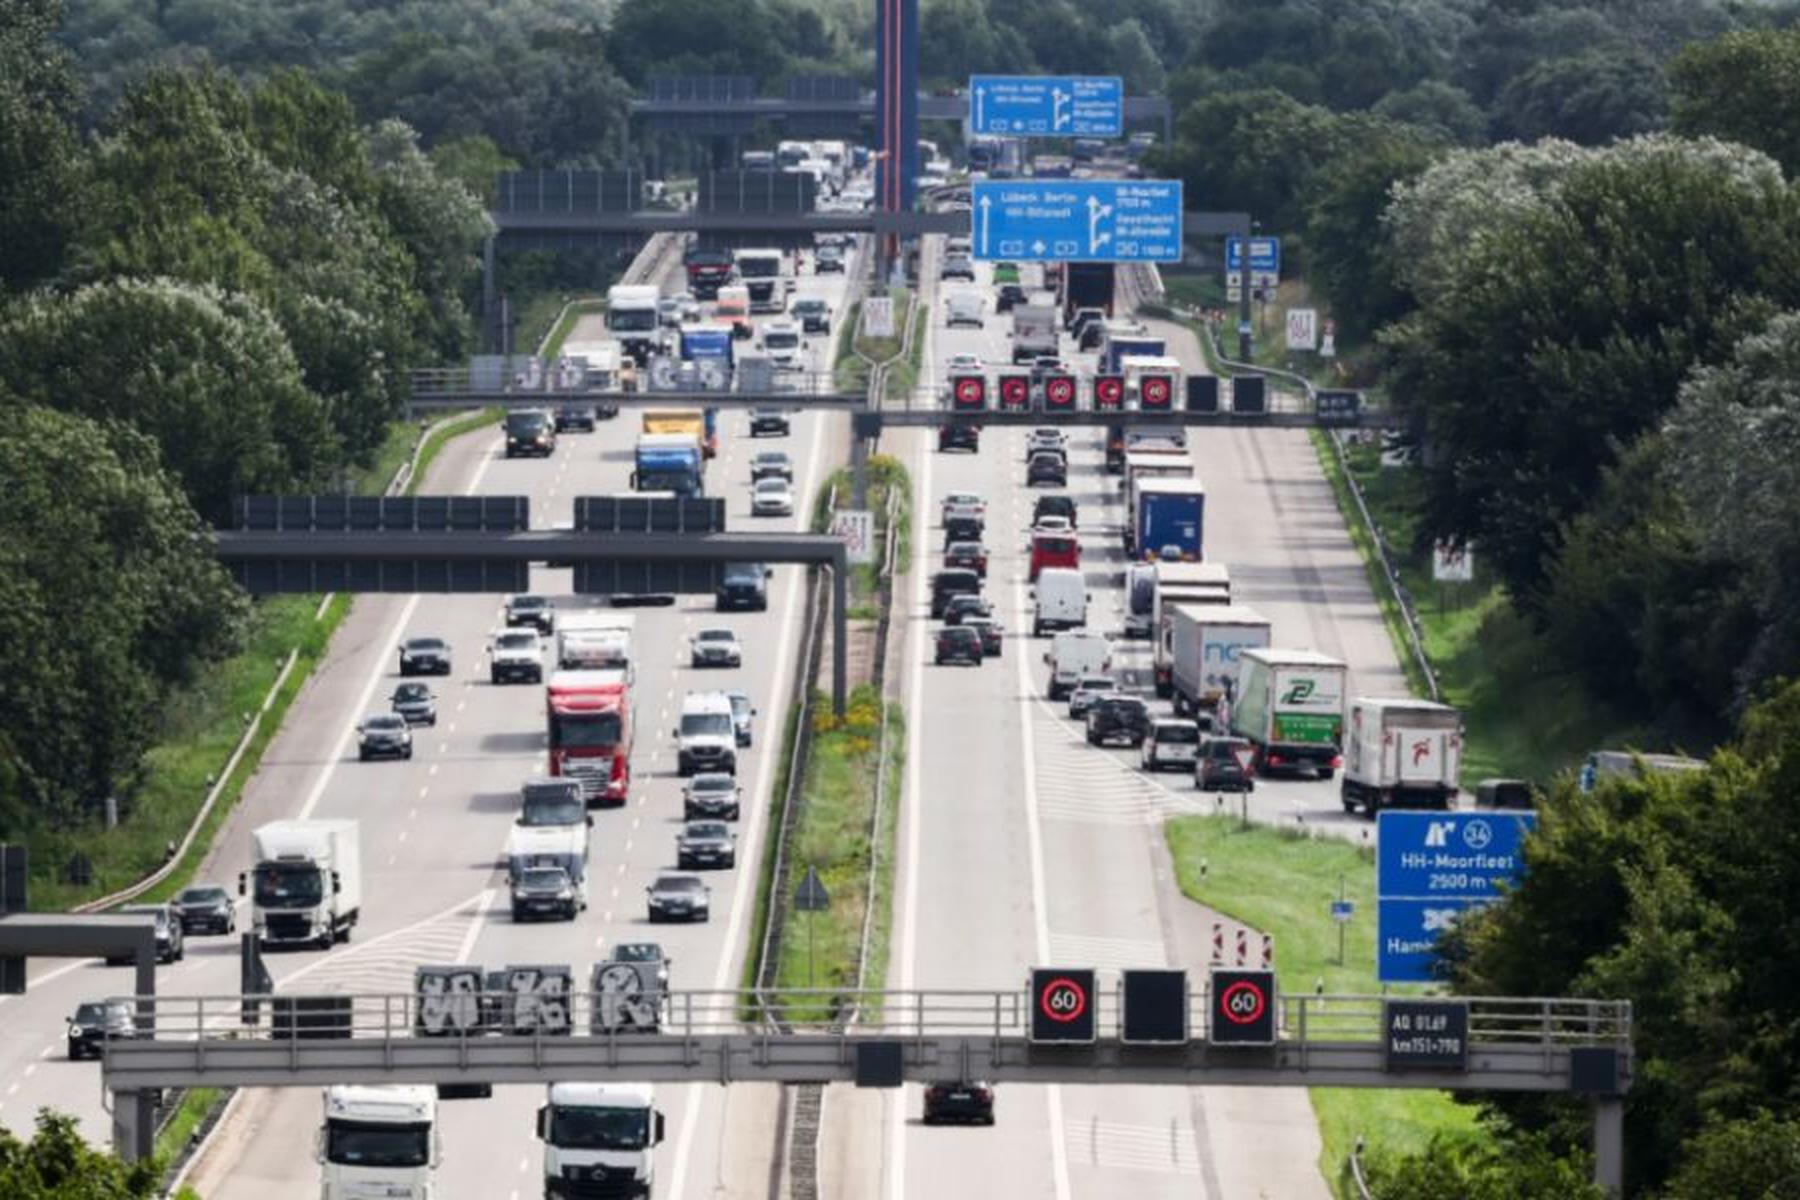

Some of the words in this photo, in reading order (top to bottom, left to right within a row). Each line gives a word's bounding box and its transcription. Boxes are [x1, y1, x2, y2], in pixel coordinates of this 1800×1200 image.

[1401, 853, 1514, 869] HH-Moorfleet
[1428, 874, 1468, 890] 2500
[1470, 877, 1487, 889] m
[1051, 988, 1077, 1010] 60
[1230, 993, 1257, 1013] 60
